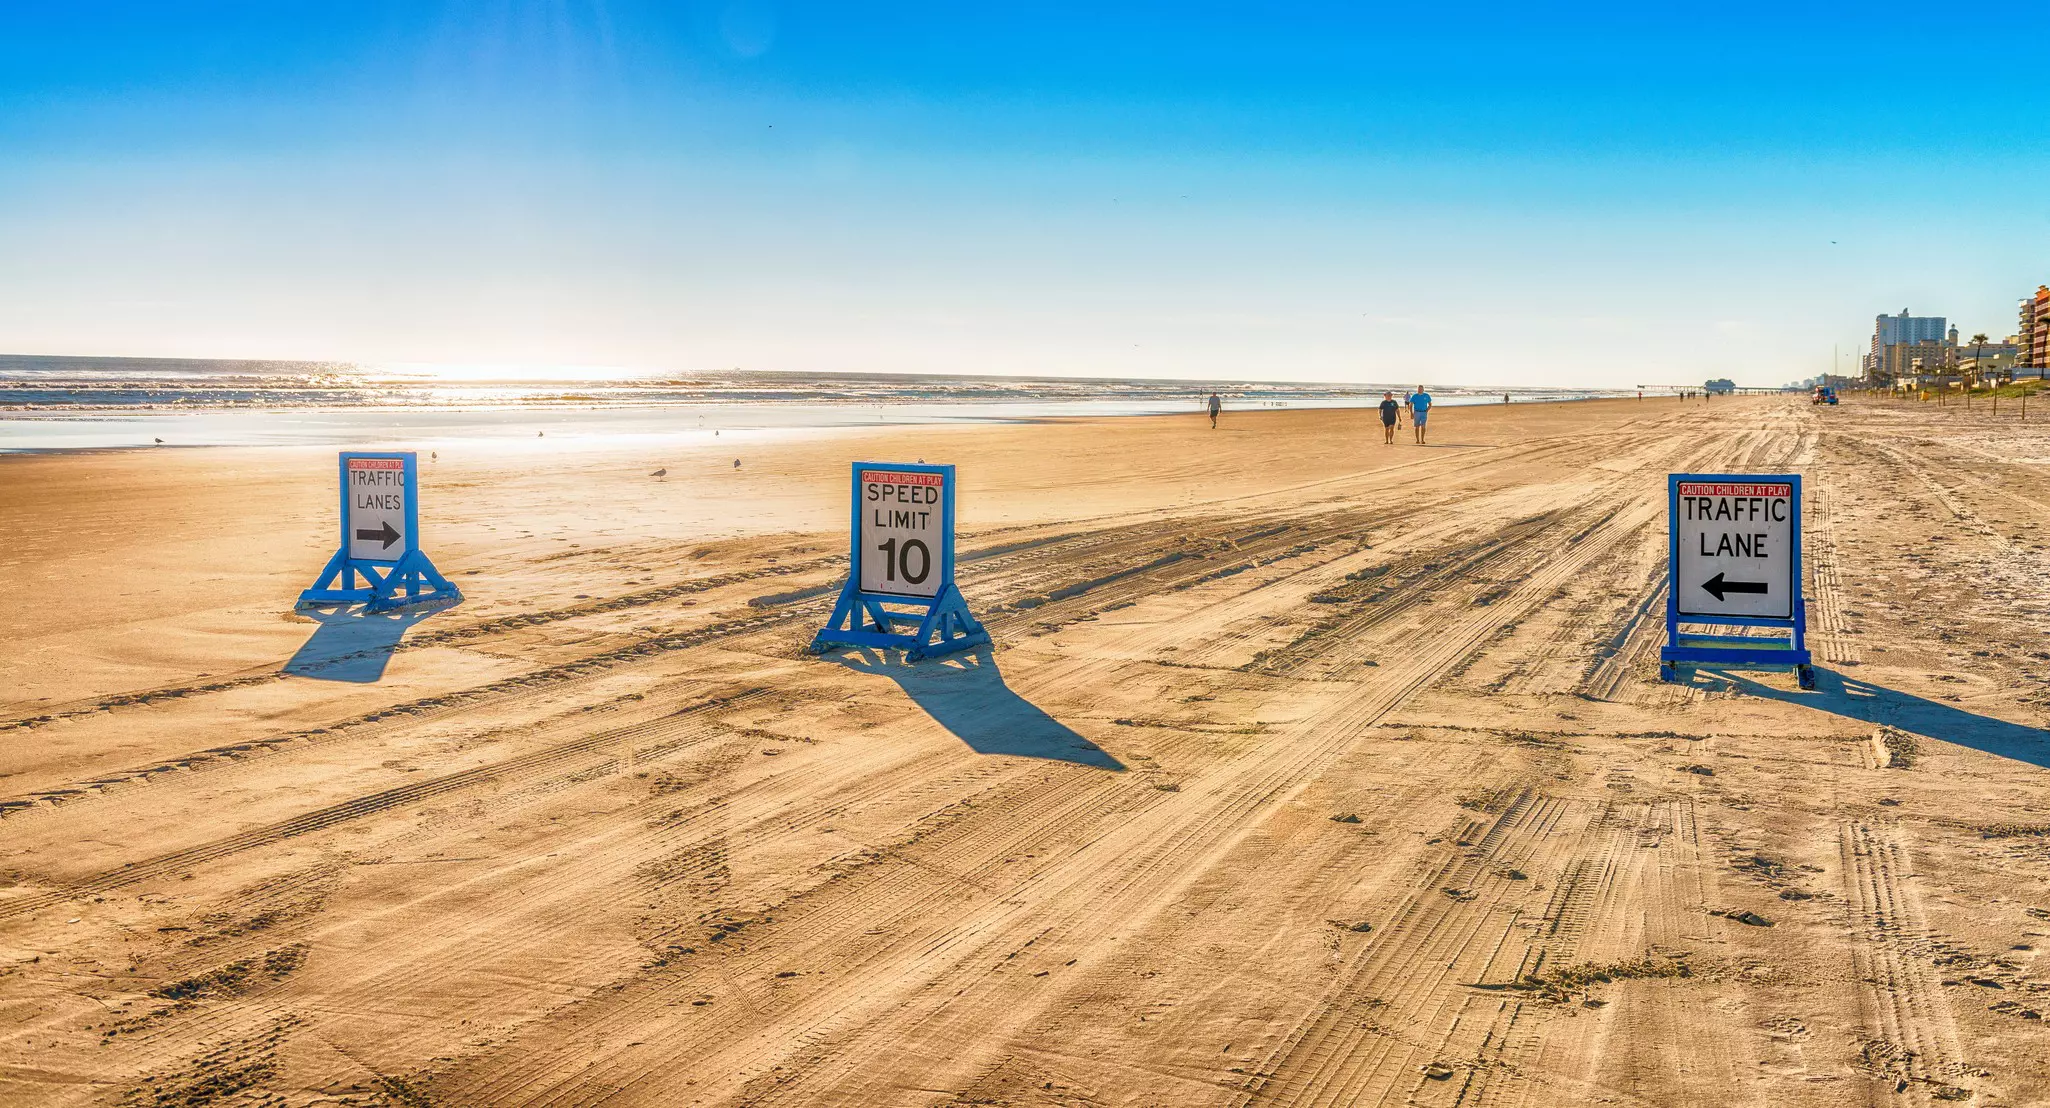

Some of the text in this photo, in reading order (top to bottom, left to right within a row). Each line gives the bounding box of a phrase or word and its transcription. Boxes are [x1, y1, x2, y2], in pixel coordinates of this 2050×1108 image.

[350, 470, 404, 487] TRAFFIC
[863, 472, 942, 486] CAUTION CHILDREN AT PLAY
[867, 483, 938, 504] SPEED
[1681, 485, 1789, 496] CAUTION CHILDREN AT PLAY
[357, 494, 401, 510] LANES
[1683, 497, 1786, 522] TRAFFIC
[875, 509, 930, 530] LIMIT
[1700, 532, 1768, 558] LANE
[877, 537, 931, 585] 10
